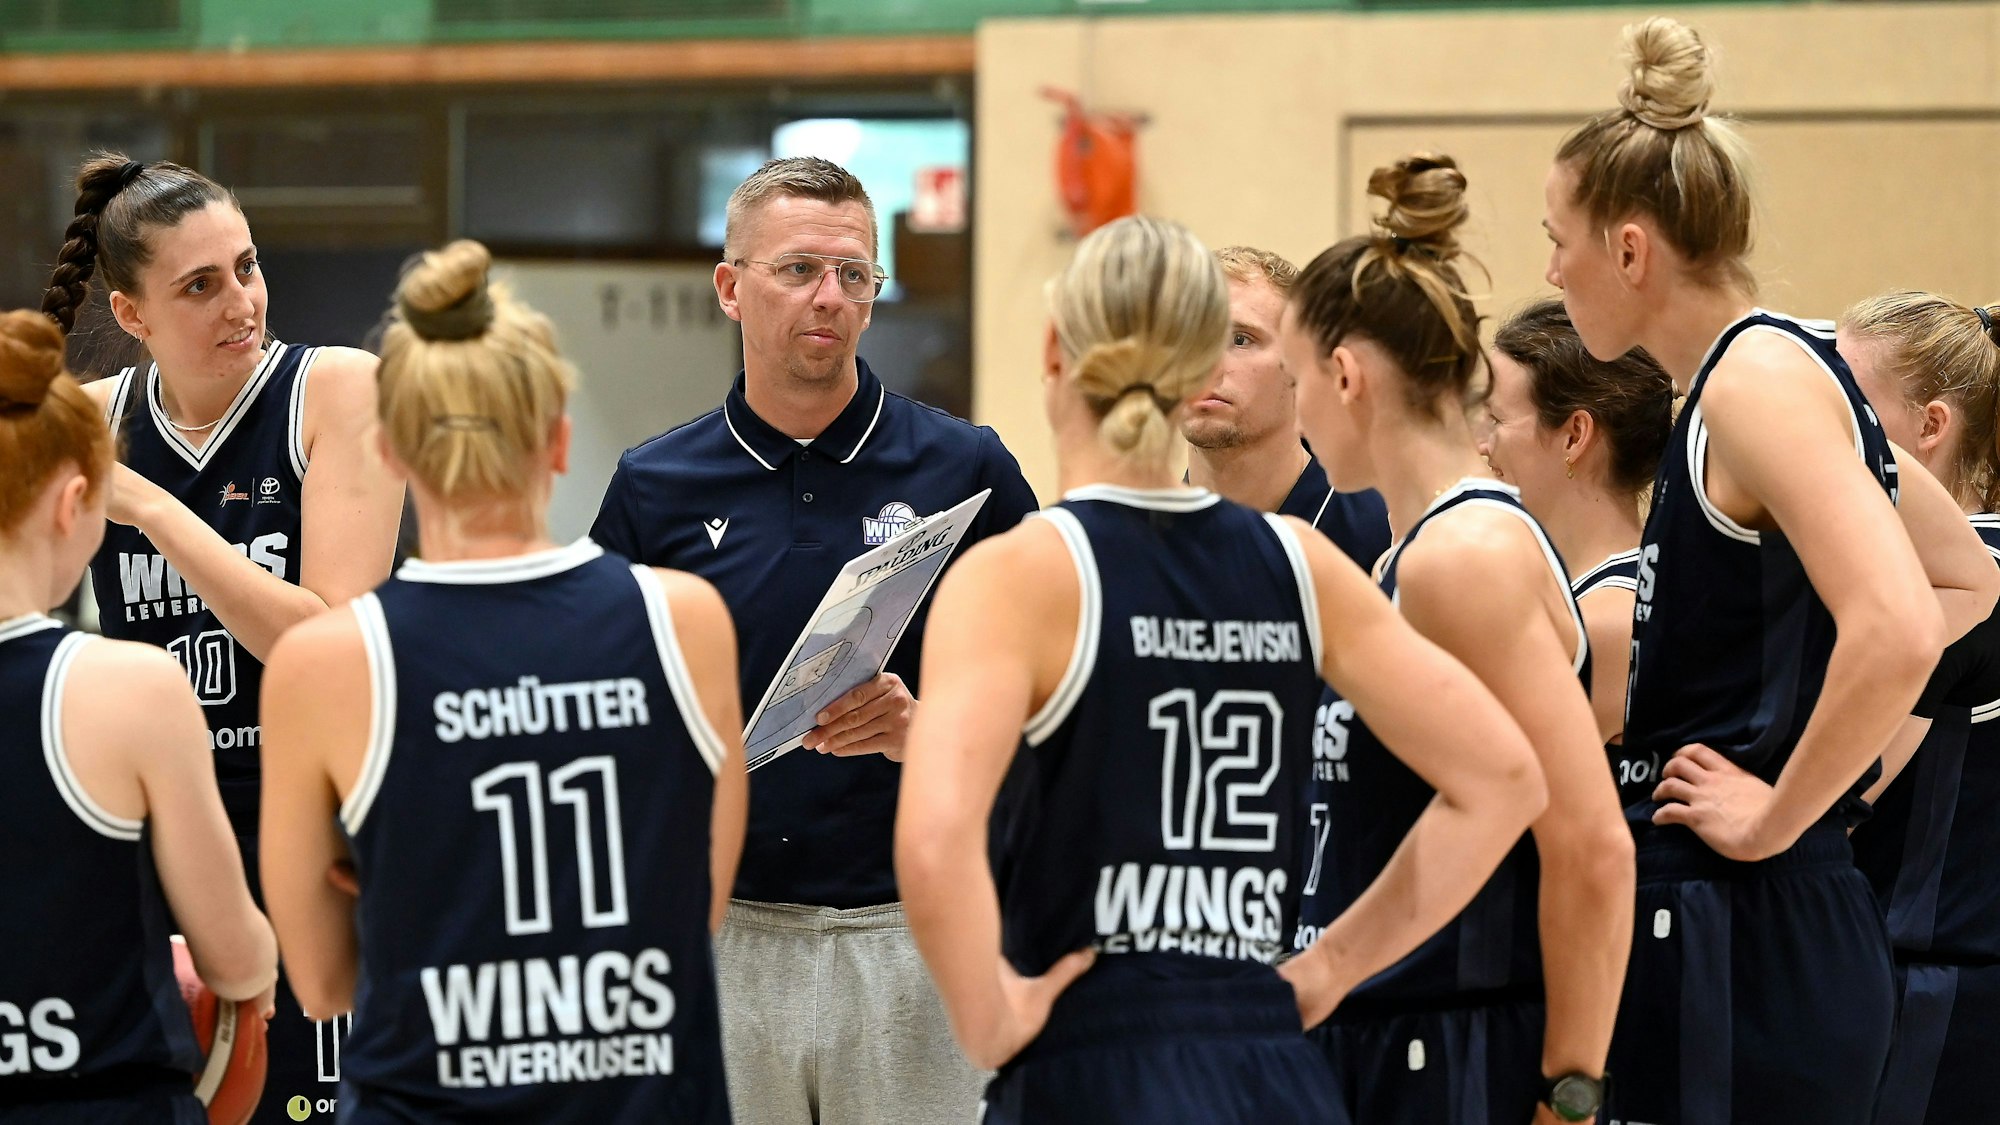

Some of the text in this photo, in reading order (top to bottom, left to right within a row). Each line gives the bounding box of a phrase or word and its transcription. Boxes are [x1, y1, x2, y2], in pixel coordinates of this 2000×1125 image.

[847, 524, 954, 594] SPALDING
[1129, 615, 1302, 663] BLAZEJEWSKI
[433, 675, 650, 743] SCHÜTTER
[1148, 687, 1284, 852] 12
[471, 755, 629, 936] 11
[1095, 862, 1288, 943] WINGS
[420, 947, 675, 1046] WINGS
[437, 1033, 674, 1089] LEVERKUSEN
